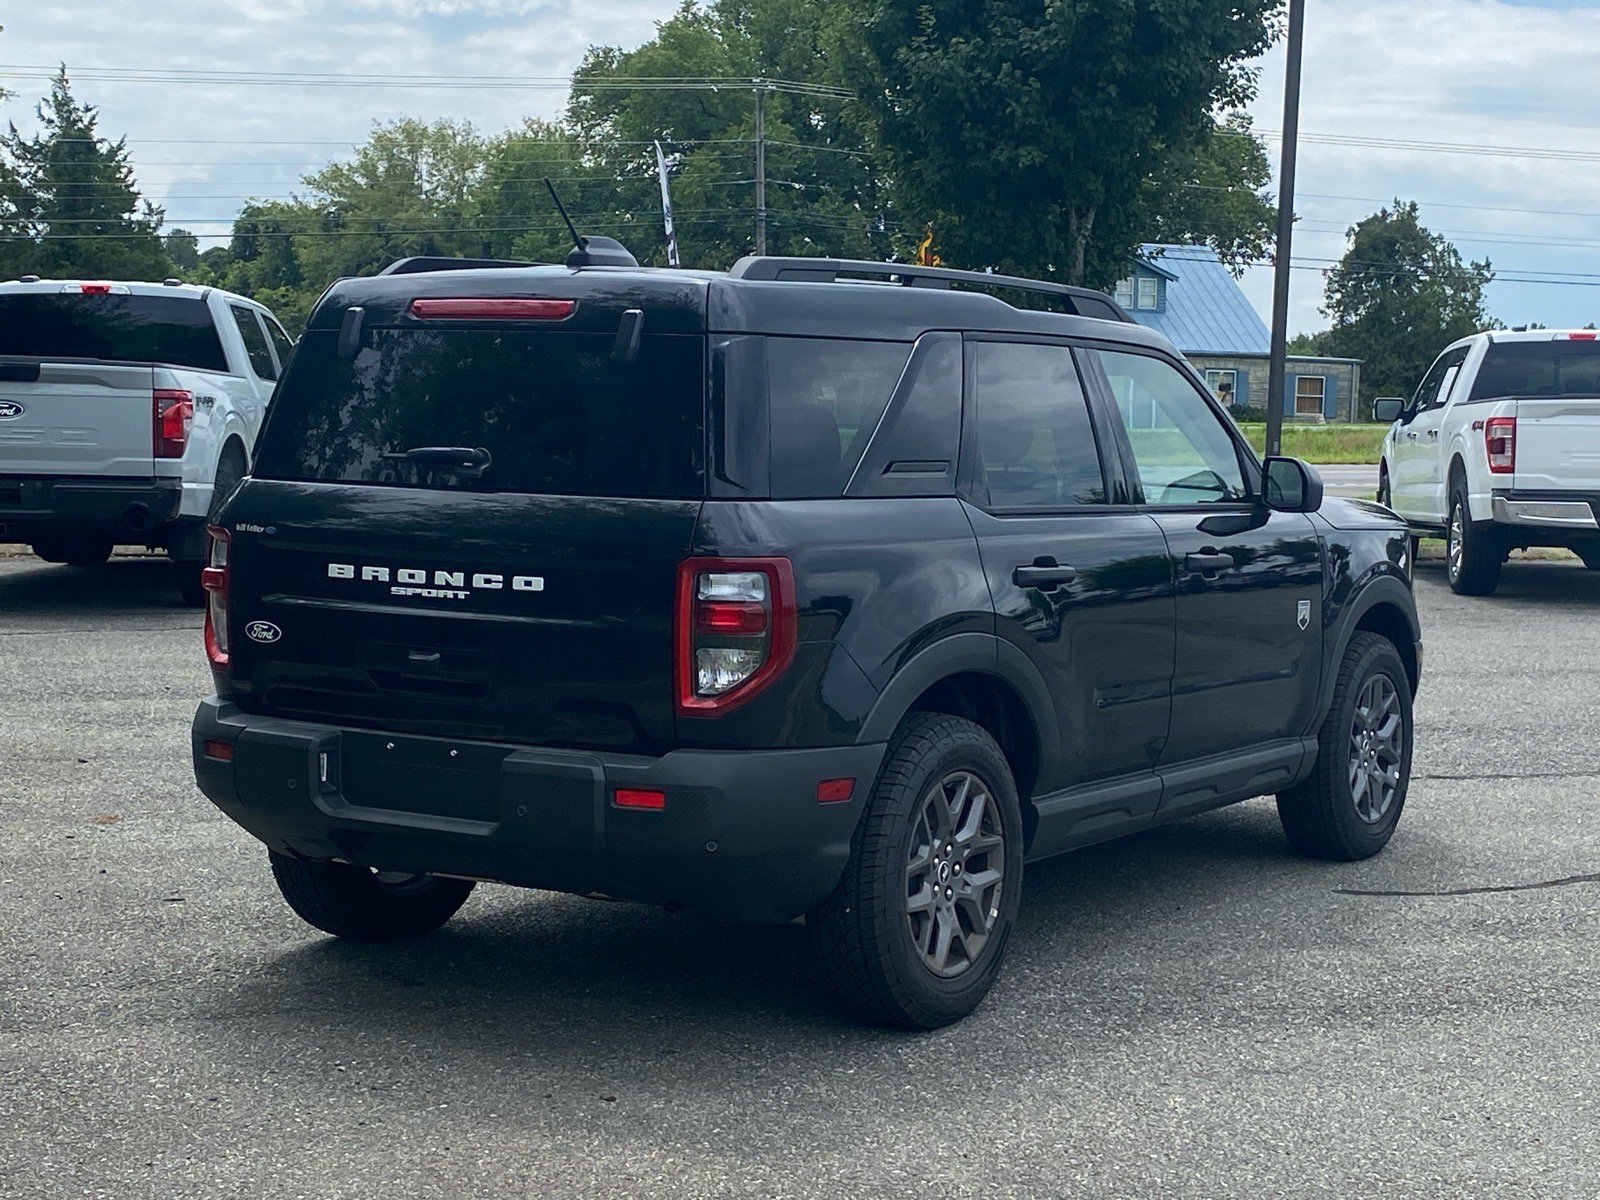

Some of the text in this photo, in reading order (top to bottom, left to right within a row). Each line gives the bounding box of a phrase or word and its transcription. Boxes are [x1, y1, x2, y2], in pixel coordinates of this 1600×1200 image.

[328, 563, 545, 592] BRONCO
[390, 586, 471, 599] SPORT
[251, 623, 275, 640] Ford
